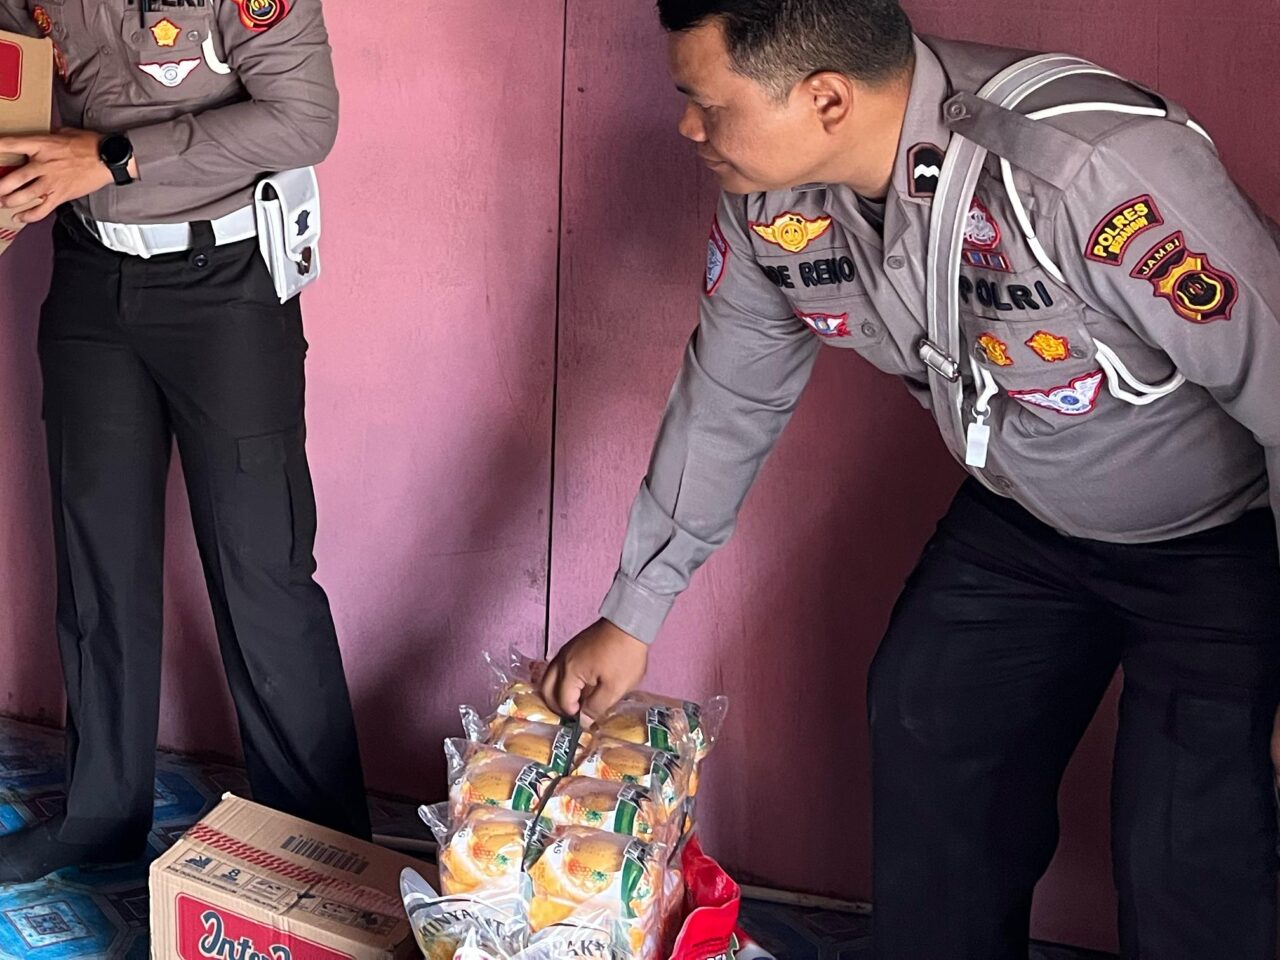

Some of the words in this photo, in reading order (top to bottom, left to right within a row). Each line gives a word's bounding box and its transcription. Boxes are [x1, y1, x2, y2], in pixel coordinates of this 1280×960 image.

[1093, 202, 1149, 257] POLRES
[1142, 238, 1180, 275] JAMBI
[959, 275, 1054, 311] POLRI
